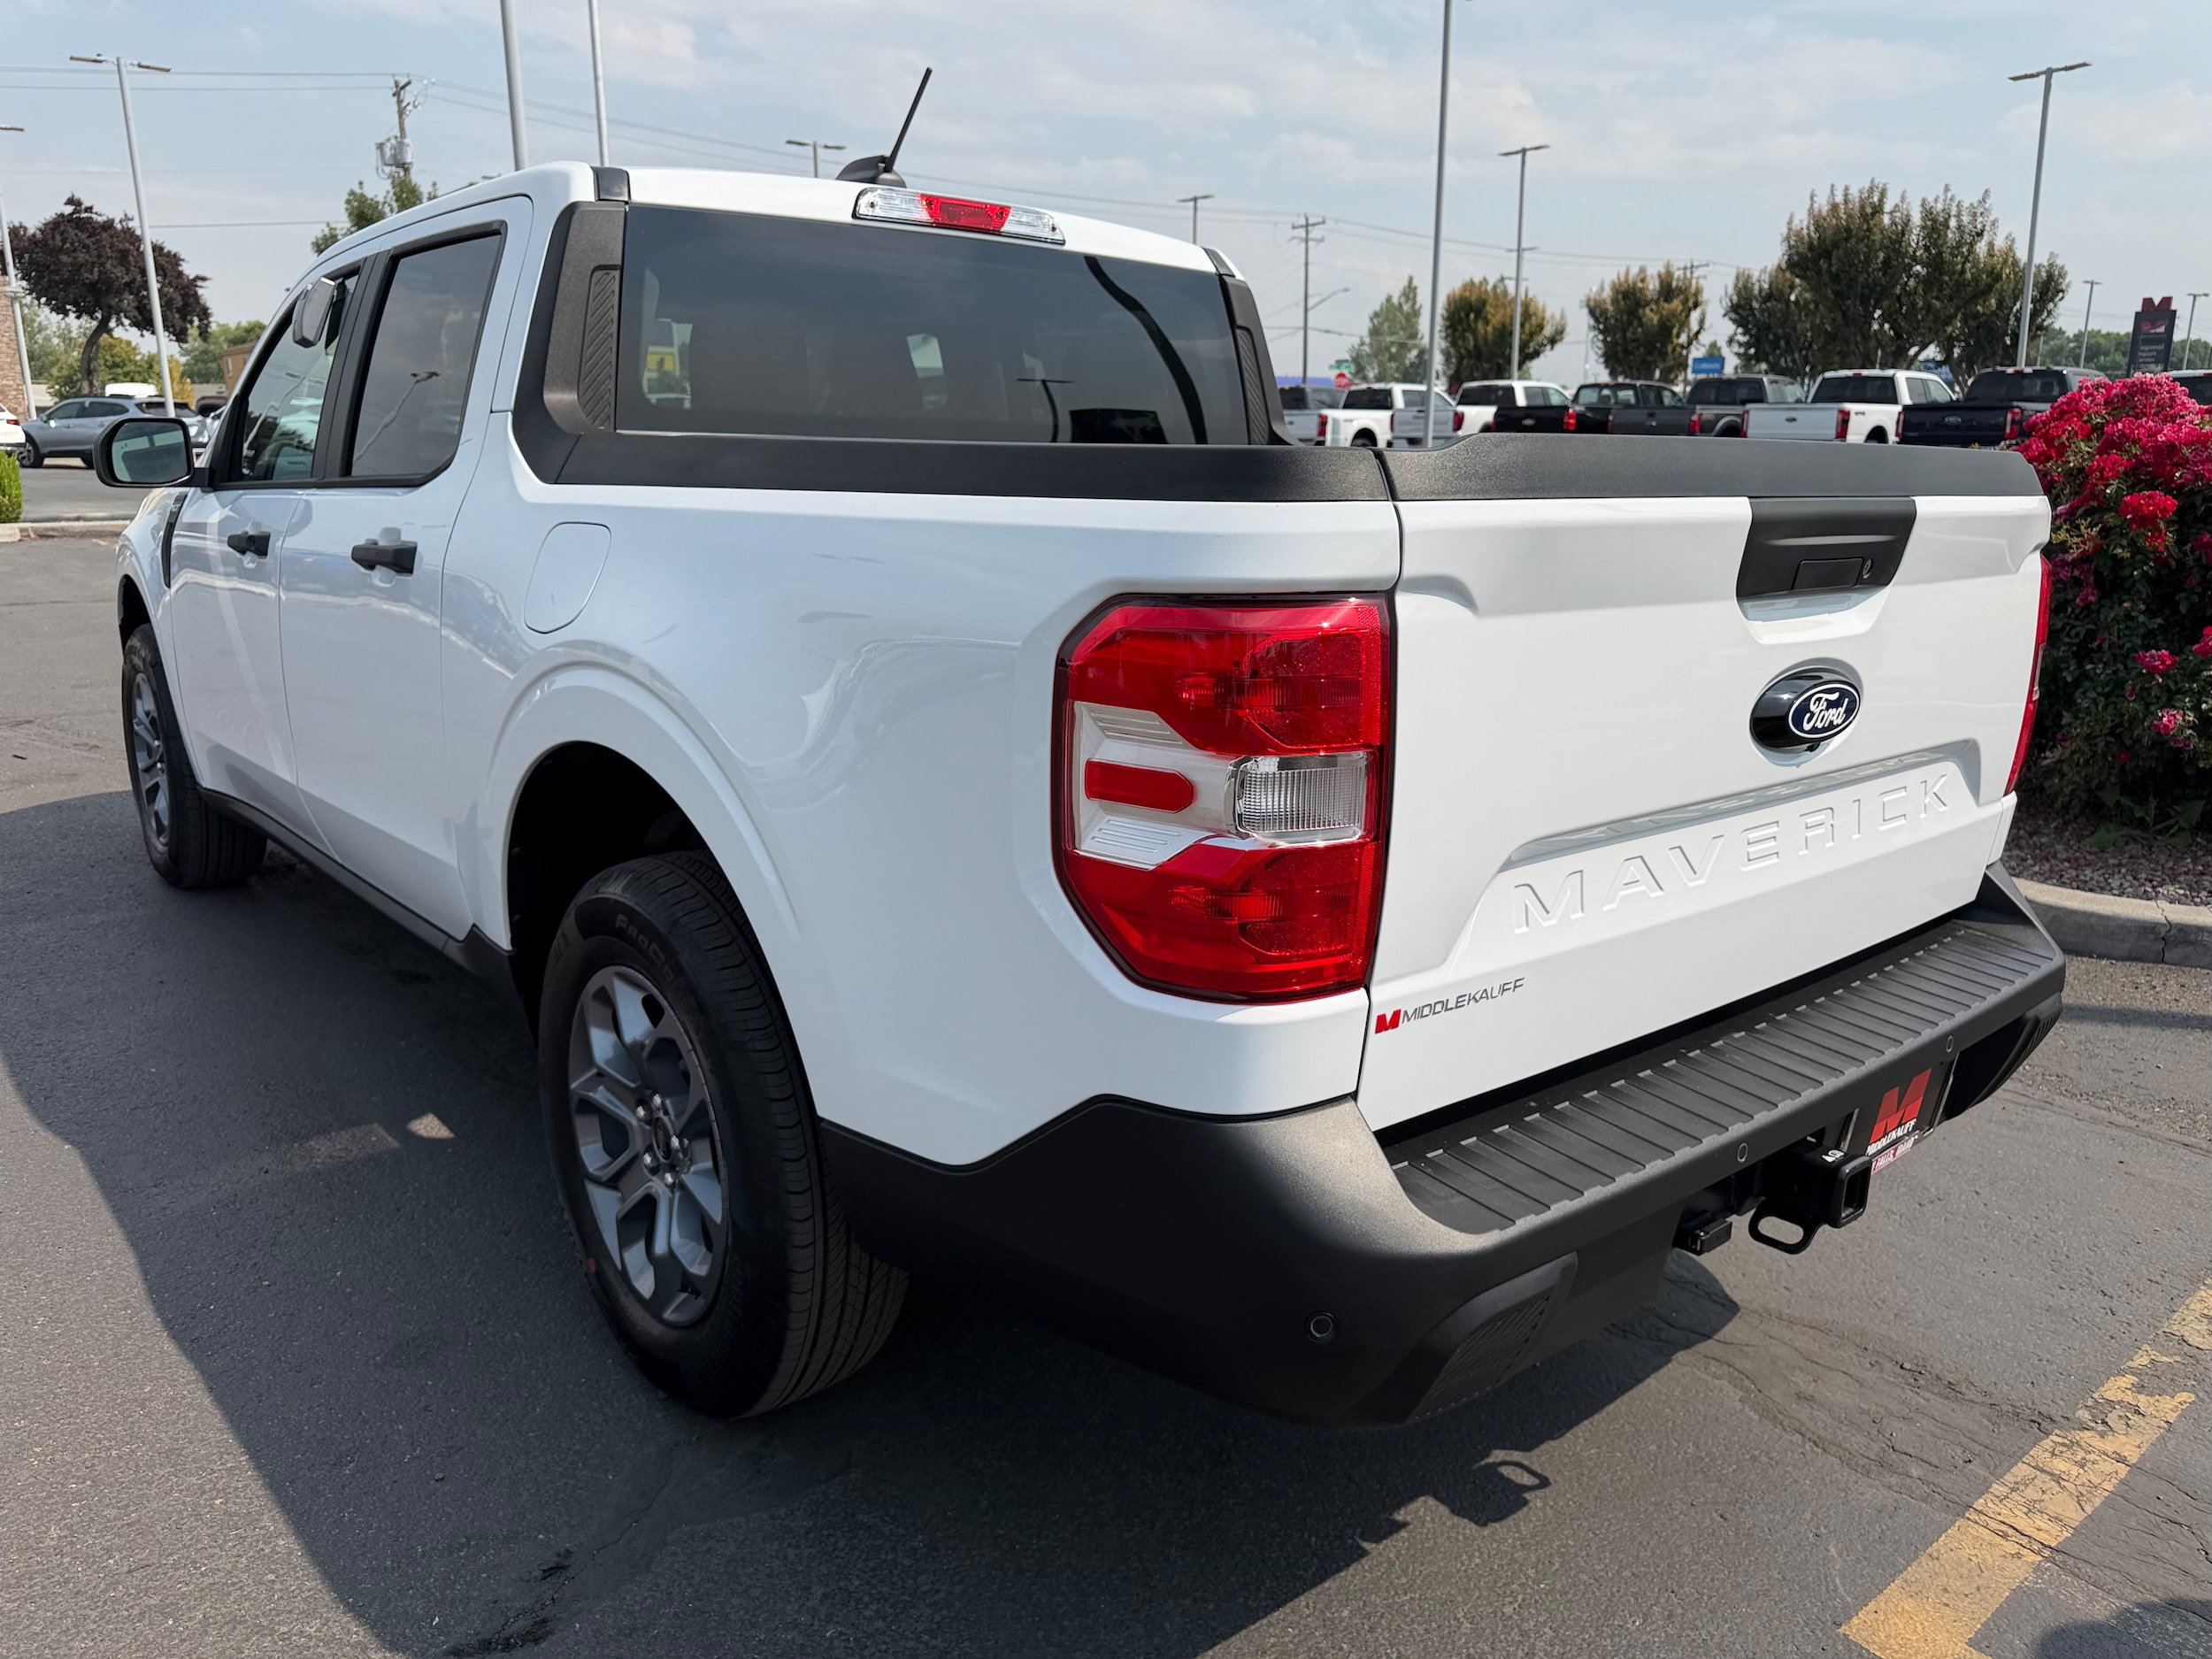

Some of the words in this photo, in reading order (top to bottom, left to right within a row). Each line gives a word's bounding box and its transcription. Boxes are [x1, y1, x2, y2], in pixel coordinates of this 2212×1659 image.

[1802, 691, 1849, 732] Ford
[1513, 773, 1948, 934] MAVERICK
[1402, 977, 1525, 1025] MIDDLEKAUFF
[1864, 1118, 1917, 1157] MIDDLEKAUFF
